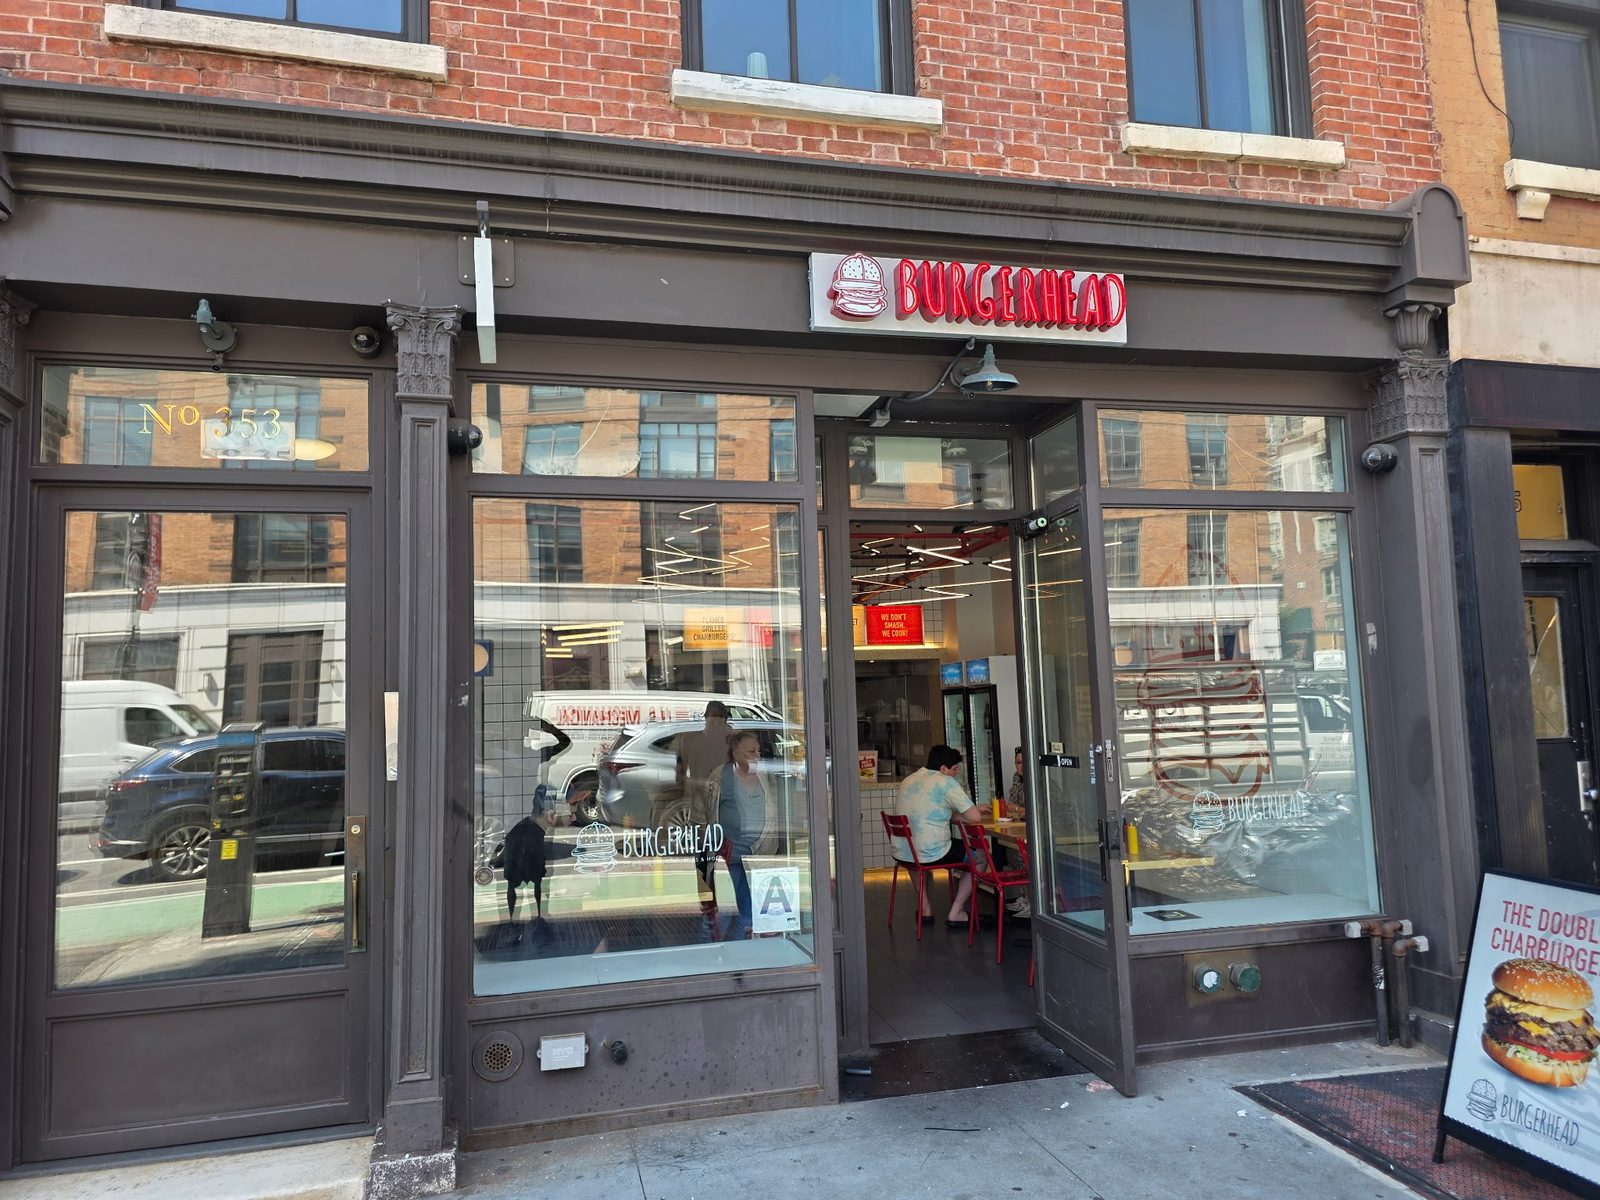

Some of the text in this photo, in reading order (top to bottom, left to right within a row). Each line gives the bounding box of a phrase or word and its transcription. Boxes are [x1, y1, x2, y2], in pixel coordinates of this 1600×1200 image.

[897, 259, 1127, 330] BURGERHEAD
[213, 406, 282, 439] 353
[881, 613, 907, 621] WE DON'T
[882, 629, 891, 637] WE
[1060, 758, 1073, 766] OPEN
[623, 823, 724, 858] BURGERHEAD
[759, 876, 793, 915] A
[1502, 900, 1600, 944] THE DOUBL
[1491, 927, 1600, 977] CHARBURGE
[1500, 1095, 1580, 1147] BURGERHEAD
